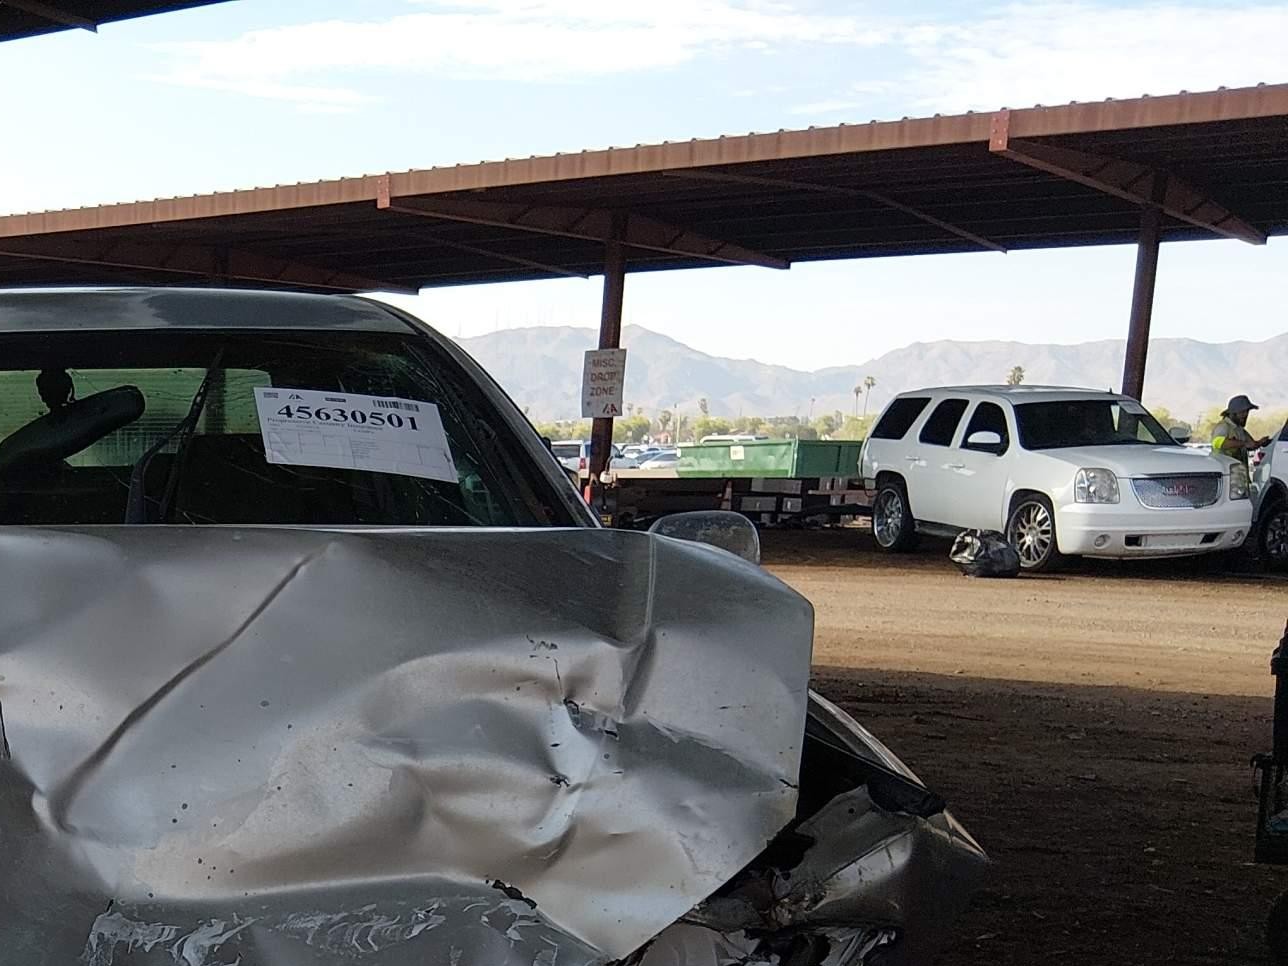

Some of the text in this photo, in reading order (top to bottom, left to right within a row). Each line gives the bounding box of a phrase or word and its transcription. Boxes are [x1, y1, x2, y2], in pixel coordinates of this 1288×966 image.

[590, 371, 617, 382] DROP
[589, 386, 615, 396] ZONE
[277, 404, 420, 431] 45630501
